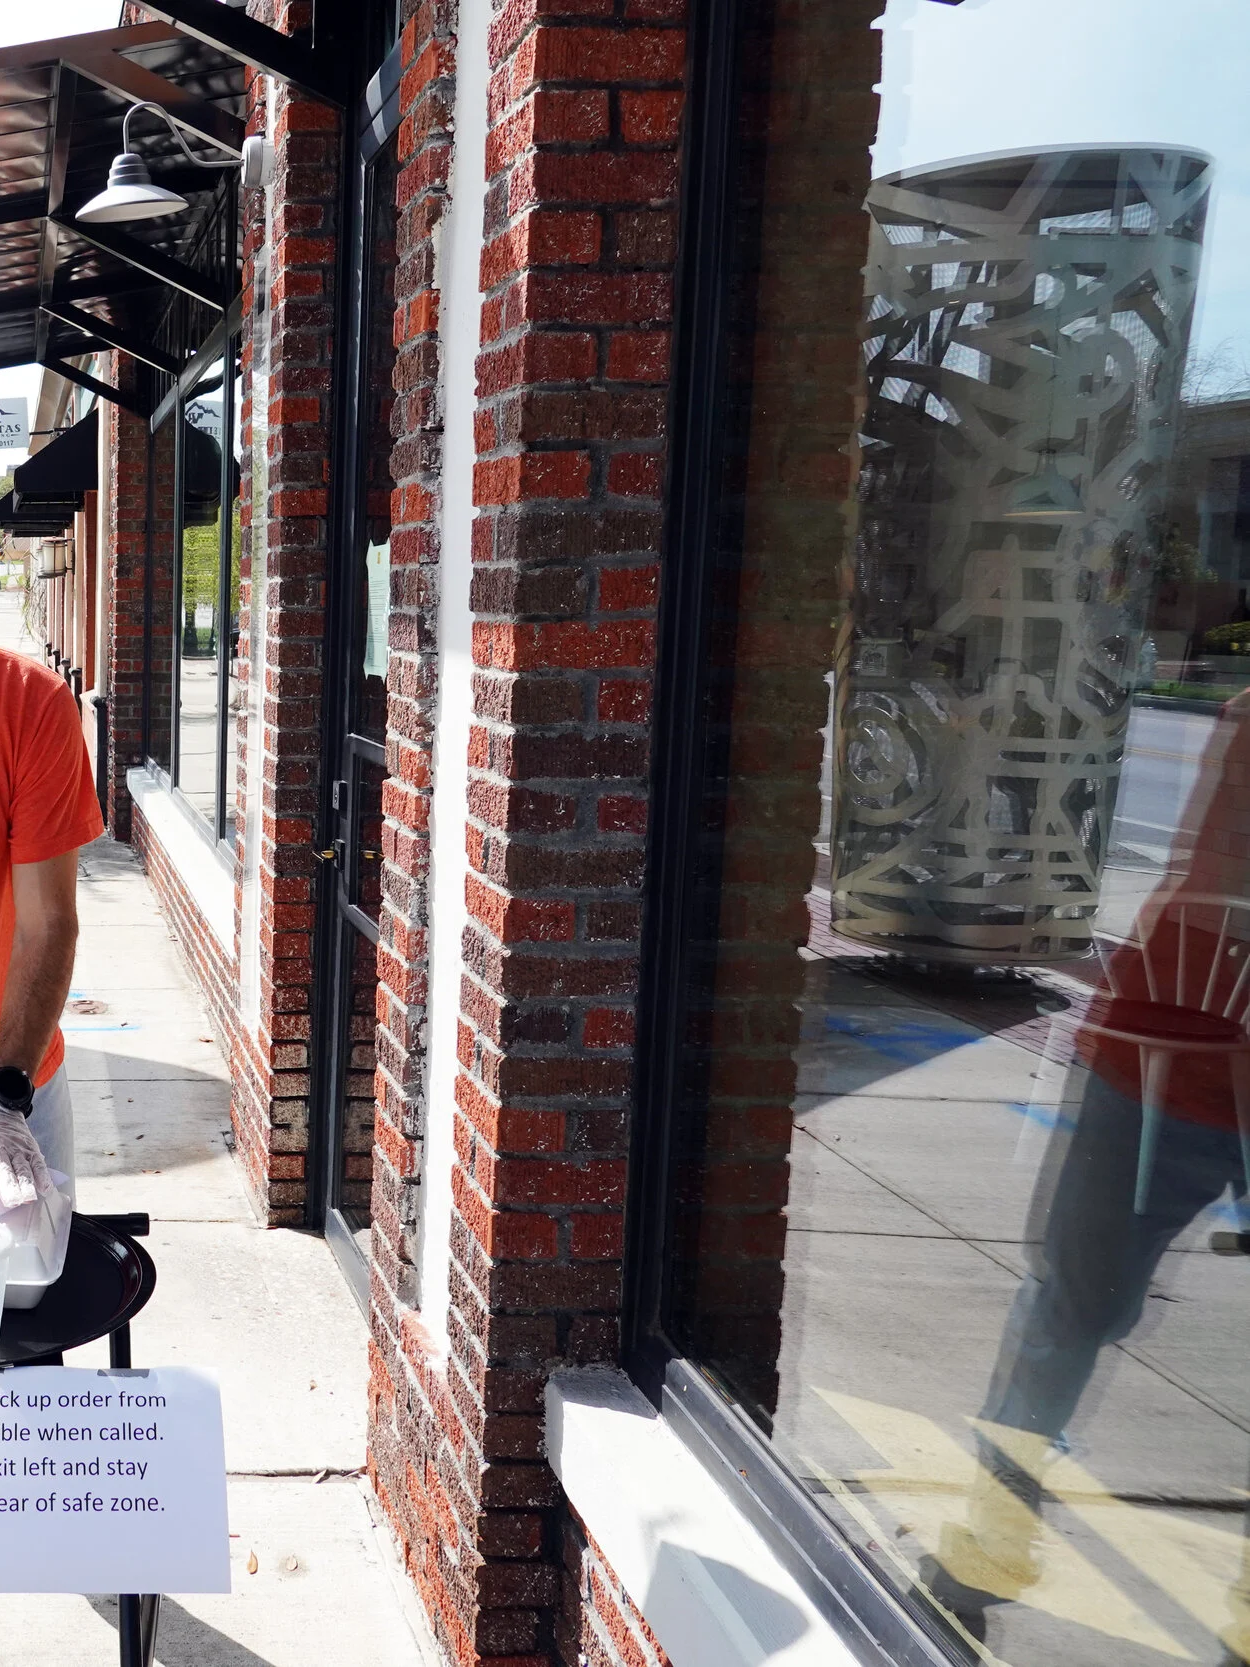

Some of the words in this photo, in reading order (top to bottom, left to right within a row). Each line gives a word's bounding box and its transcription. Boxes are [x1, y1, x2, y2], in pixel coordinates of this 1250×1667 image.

[27, 1394, 52, 1412] up
[57, 1390, 113, 1408] order
[118, 1390, 168, 1408] from
[37, 1422, 93, 1442] when
[99, 1421, 164, 1441] called.
[23, 1456, 57, 1477] left
[62, 1456, 101, 1476] and
[106, 1458, 149, 1481] stay
[35, 1491, 58, 1513] of
[62, 1491, 104, 1512] safe
[110, 1497, 166, 1512] zone.
